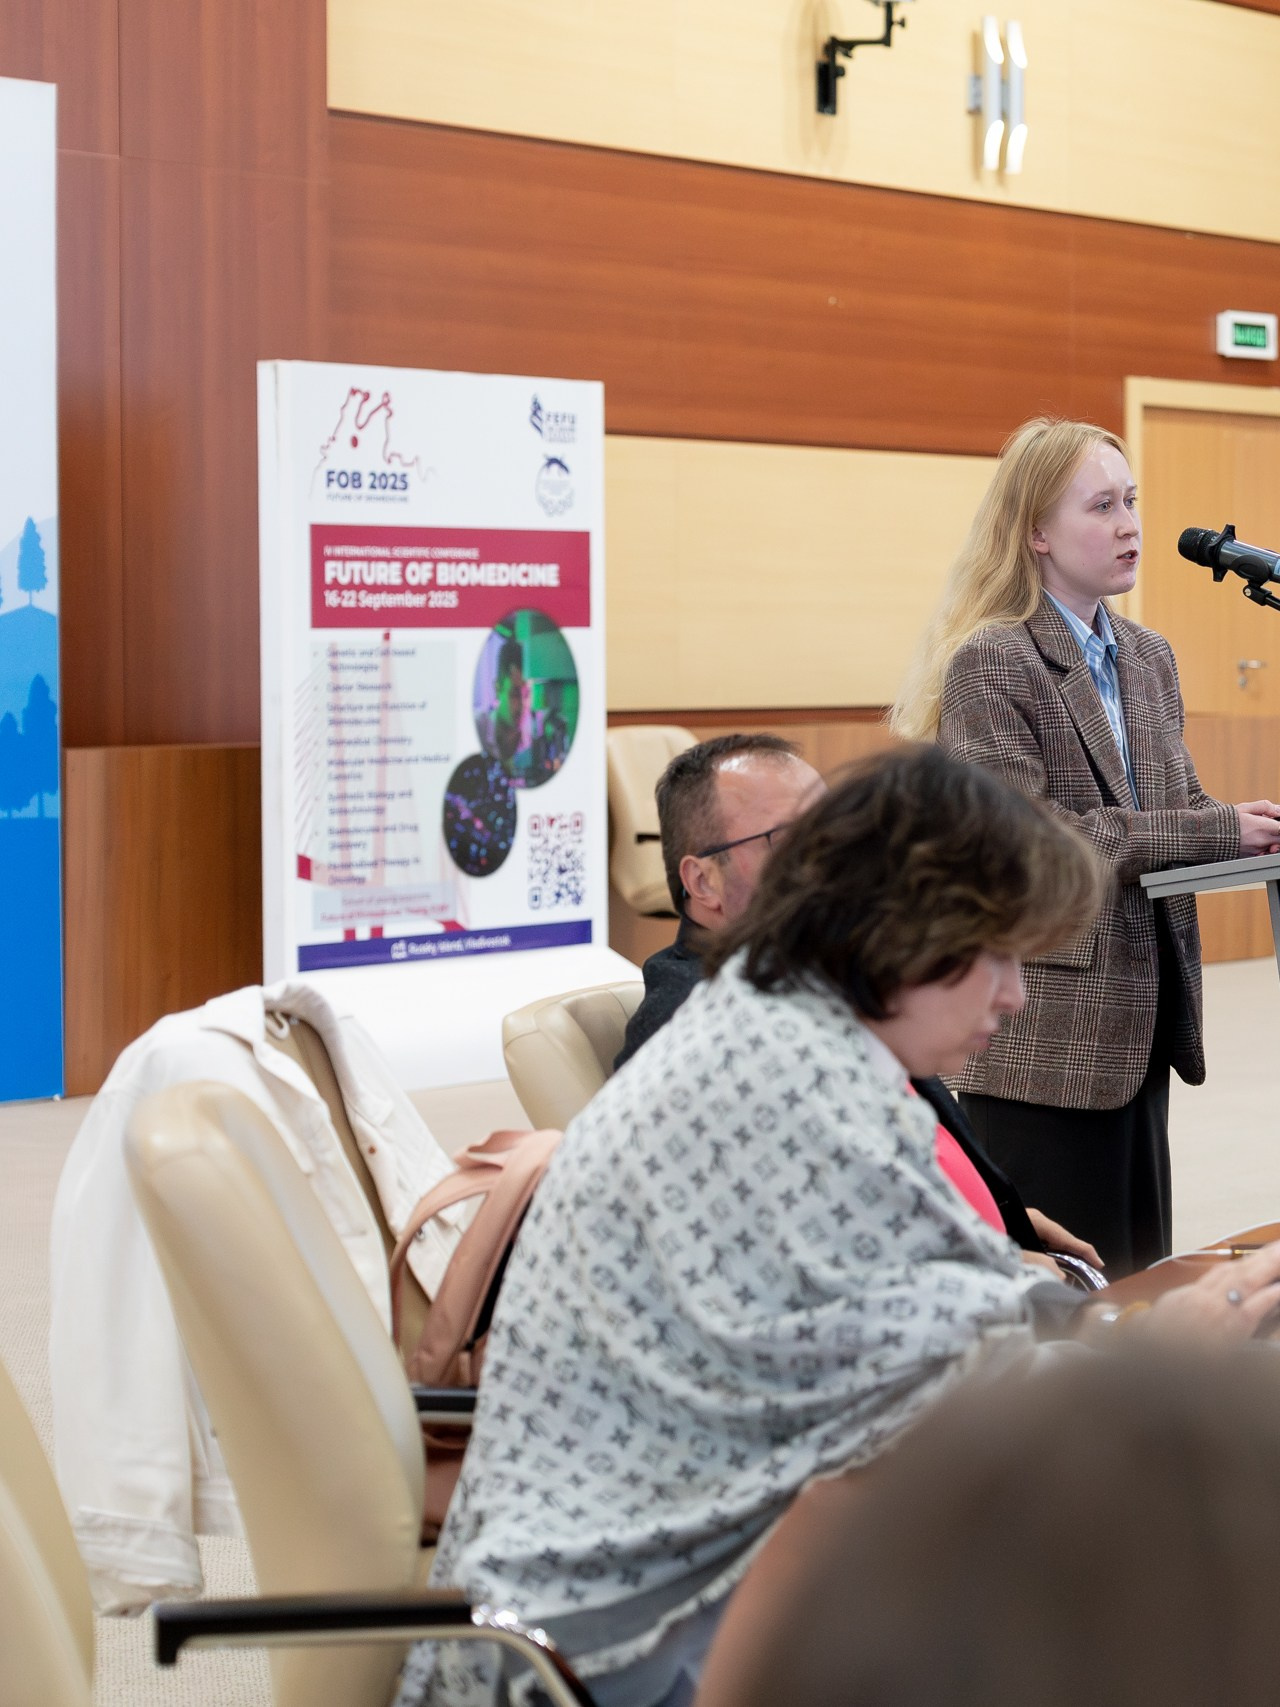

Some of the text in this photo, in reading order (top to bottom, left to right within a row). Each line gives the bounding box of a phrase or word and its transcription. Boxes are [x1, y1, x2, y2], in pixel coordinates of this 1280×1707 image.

[327, 470, 408, 490] FOB 2025
[324, 560, 560, 587] FUTURE OF BIOMEDICINE
[324, 589, 459, 611] 16-22 September 2025
